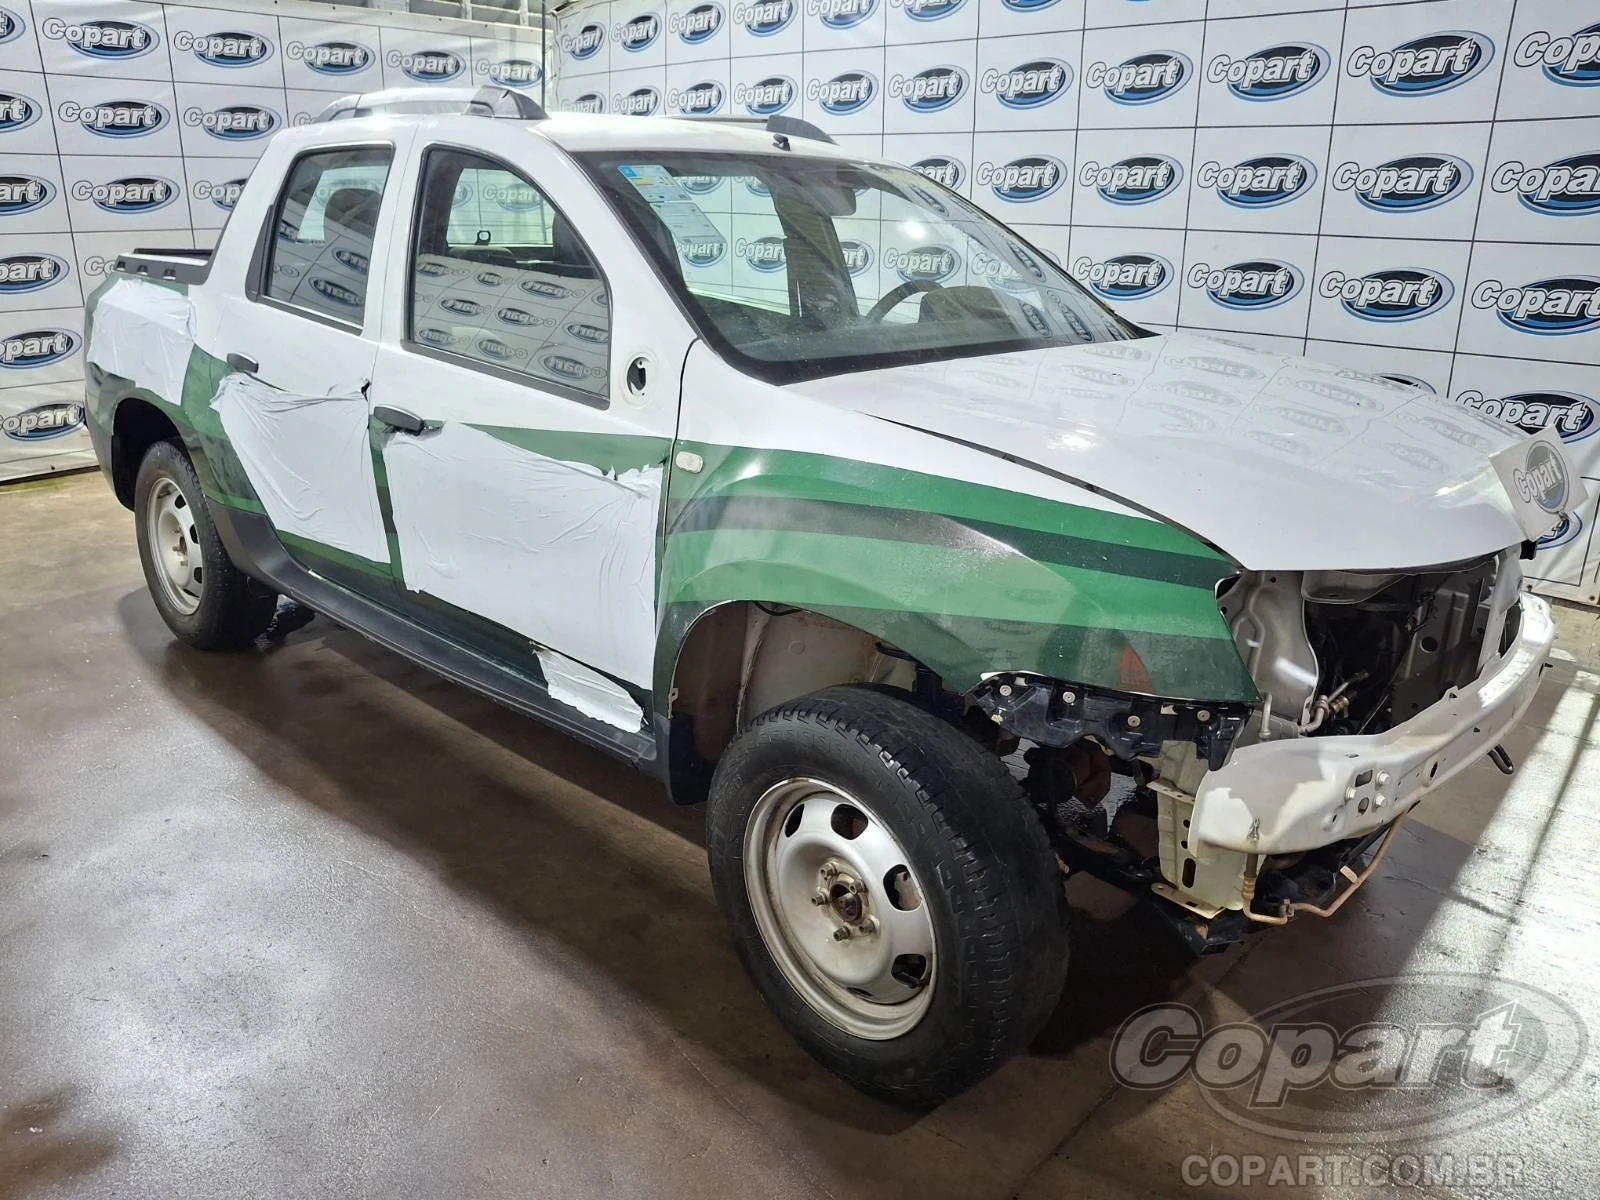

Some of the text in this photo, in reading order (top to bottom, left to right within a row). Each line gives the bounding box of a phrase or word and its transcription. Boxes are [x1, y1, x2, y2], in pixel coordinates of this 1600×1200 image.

[669, 9, 721, 36] Copart
[733, 1, 789, 29] Copart
[42, 17, 146, 48] Copart
[174, 31, 263, 57] Copart
[286, 41, 365, 66] Copart
[387, 50, 456, 74] Copart
[1347, 38, 1476, 84] Copart
[1514, 31, 1600, 74] Cop
[476, 59, 539, 81] Copart
[980, 65, 1063, 99] Copart
[1086, 56, 1179, 95] Copart
[1207, 48, 1314, 90] Copart
[667, 85, 721, 113] Copart
[735, 82, 791, 110] Copart
[807, 76, 869, 106] Copart
[888, 71, 959, 103] Copart
[58, 101, 157, 128] Copart
[184, 107, 269, 133] Copart
[72, 180, 167, 205] Copart
[976, 161, 1057, 192] Copart
[1079, 161, 1171, 195] Copart
[1197, 161, 1301, 196] Copart
[1333, 161, 1456, 199] Copart
[883, 247, 951, 276] Copart
[1073, 256, 1163, 289] Copart
[1187, 263, 1290, 298] Copart
[1319, 271, 1437, 308] Copart
[1472, 279, 1600, 319] Copart
[0, 404, 82, 436] opart
[1456, 390, 1586, 432] Copart
[1513, 451, 1563, 504] Copart
